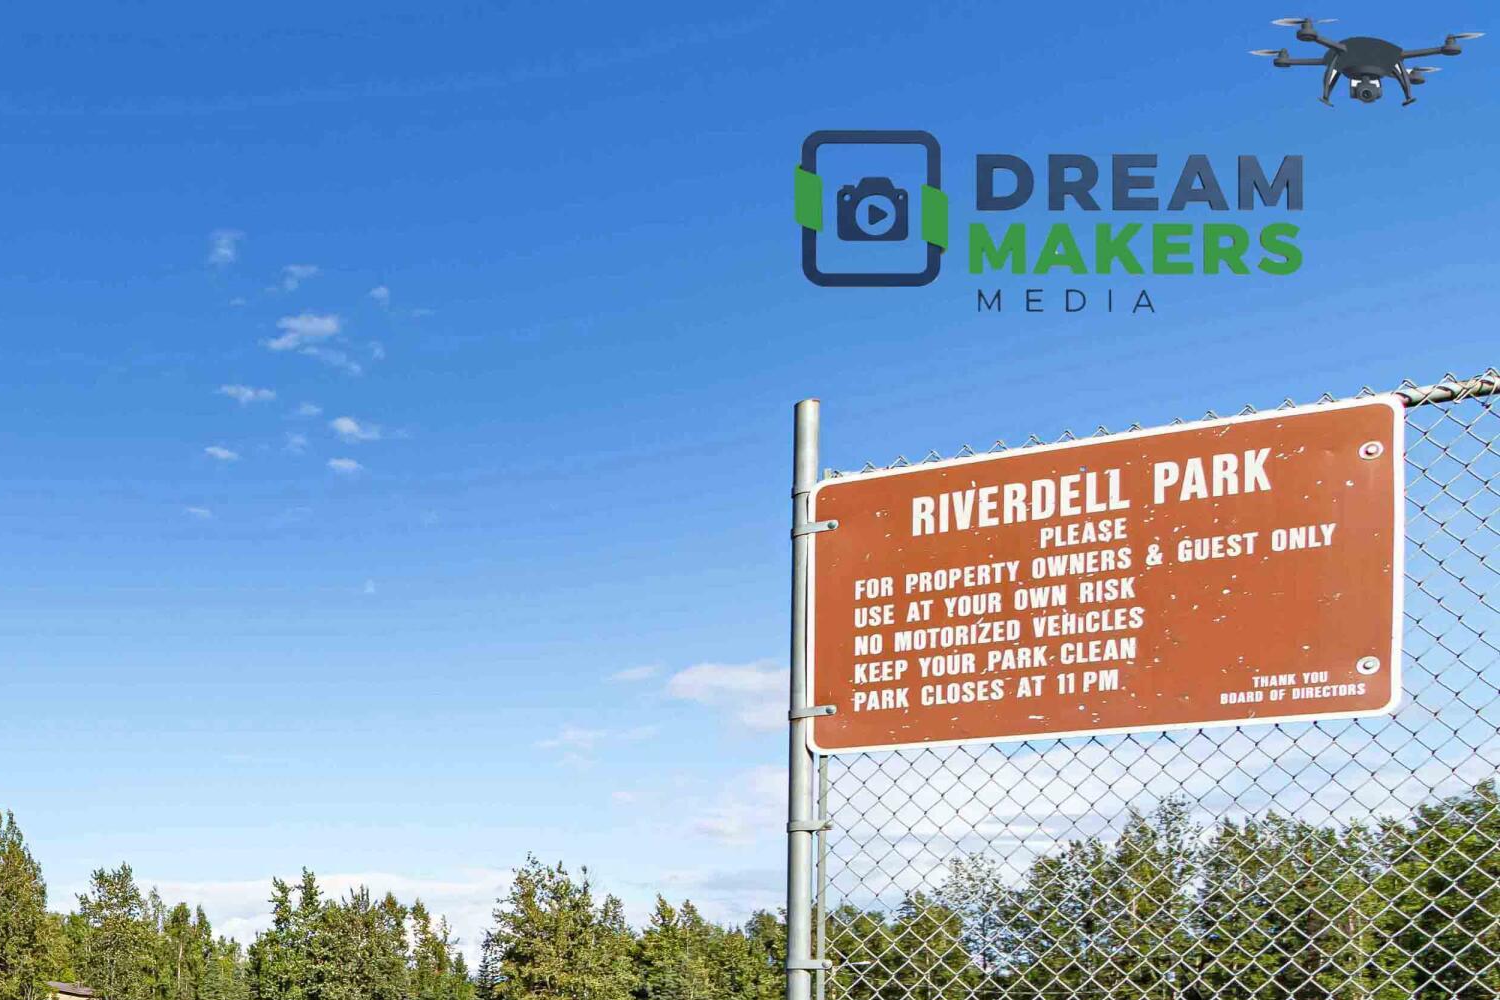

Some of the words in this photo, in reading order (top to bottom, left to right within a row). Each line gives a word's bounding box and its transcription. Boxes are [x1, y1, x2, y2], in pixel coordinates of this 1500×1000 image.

[911, 469, 1131, 536] RIVERDELL
[1153, 447, 1272, 504] PARK
[1040, 518, 1128, 549] PLEASE
[854, 576, 894, 600] FOR
[905, 560, 1020, 594] PROPERTY
[1032, 547, 1132, 579] OWNERS
[1146, 544, 1163, 567] &
[1177, 532, 1259, 562] GUEST
[1271, 523, 1337, 553] ONLY
[854, 604, 895, 628] USE
[906, 600, 934, 623] AT
[944, 592, 1002, 618] YOUR
[1014, 584, 1067, 611] OWN
[1079, 576, 1136, 604] RISK
[854, 633, 883, 656] NO
[894, 619, 1021, 653] MOTORIZED
[1033, 606, 1145, 638] VEHICLES
[854, 659, 909, 684] KEEP
[918, 653, 976, 678] YOUR
[987, 645, 1048, 672] PARK
[1060, 637, 1137, 665] CLEAN
[1252, 673, 1296, 688] THANK
[1303, 671, 1329, 684] YOU
[853, 687, 909, 712] PARK
[920, 679, 1005, 706] CLOSES
[1016, 675, 1046, 698] AT
[1056, 672, 1075, 695] 11
[1082, 669, 1119, 693] PM
[1220, 691, 1264, 705] BOARD
[1269, 688, 1286, 701] OF
[1292, 683, 1366, 700] DIRECTORS
